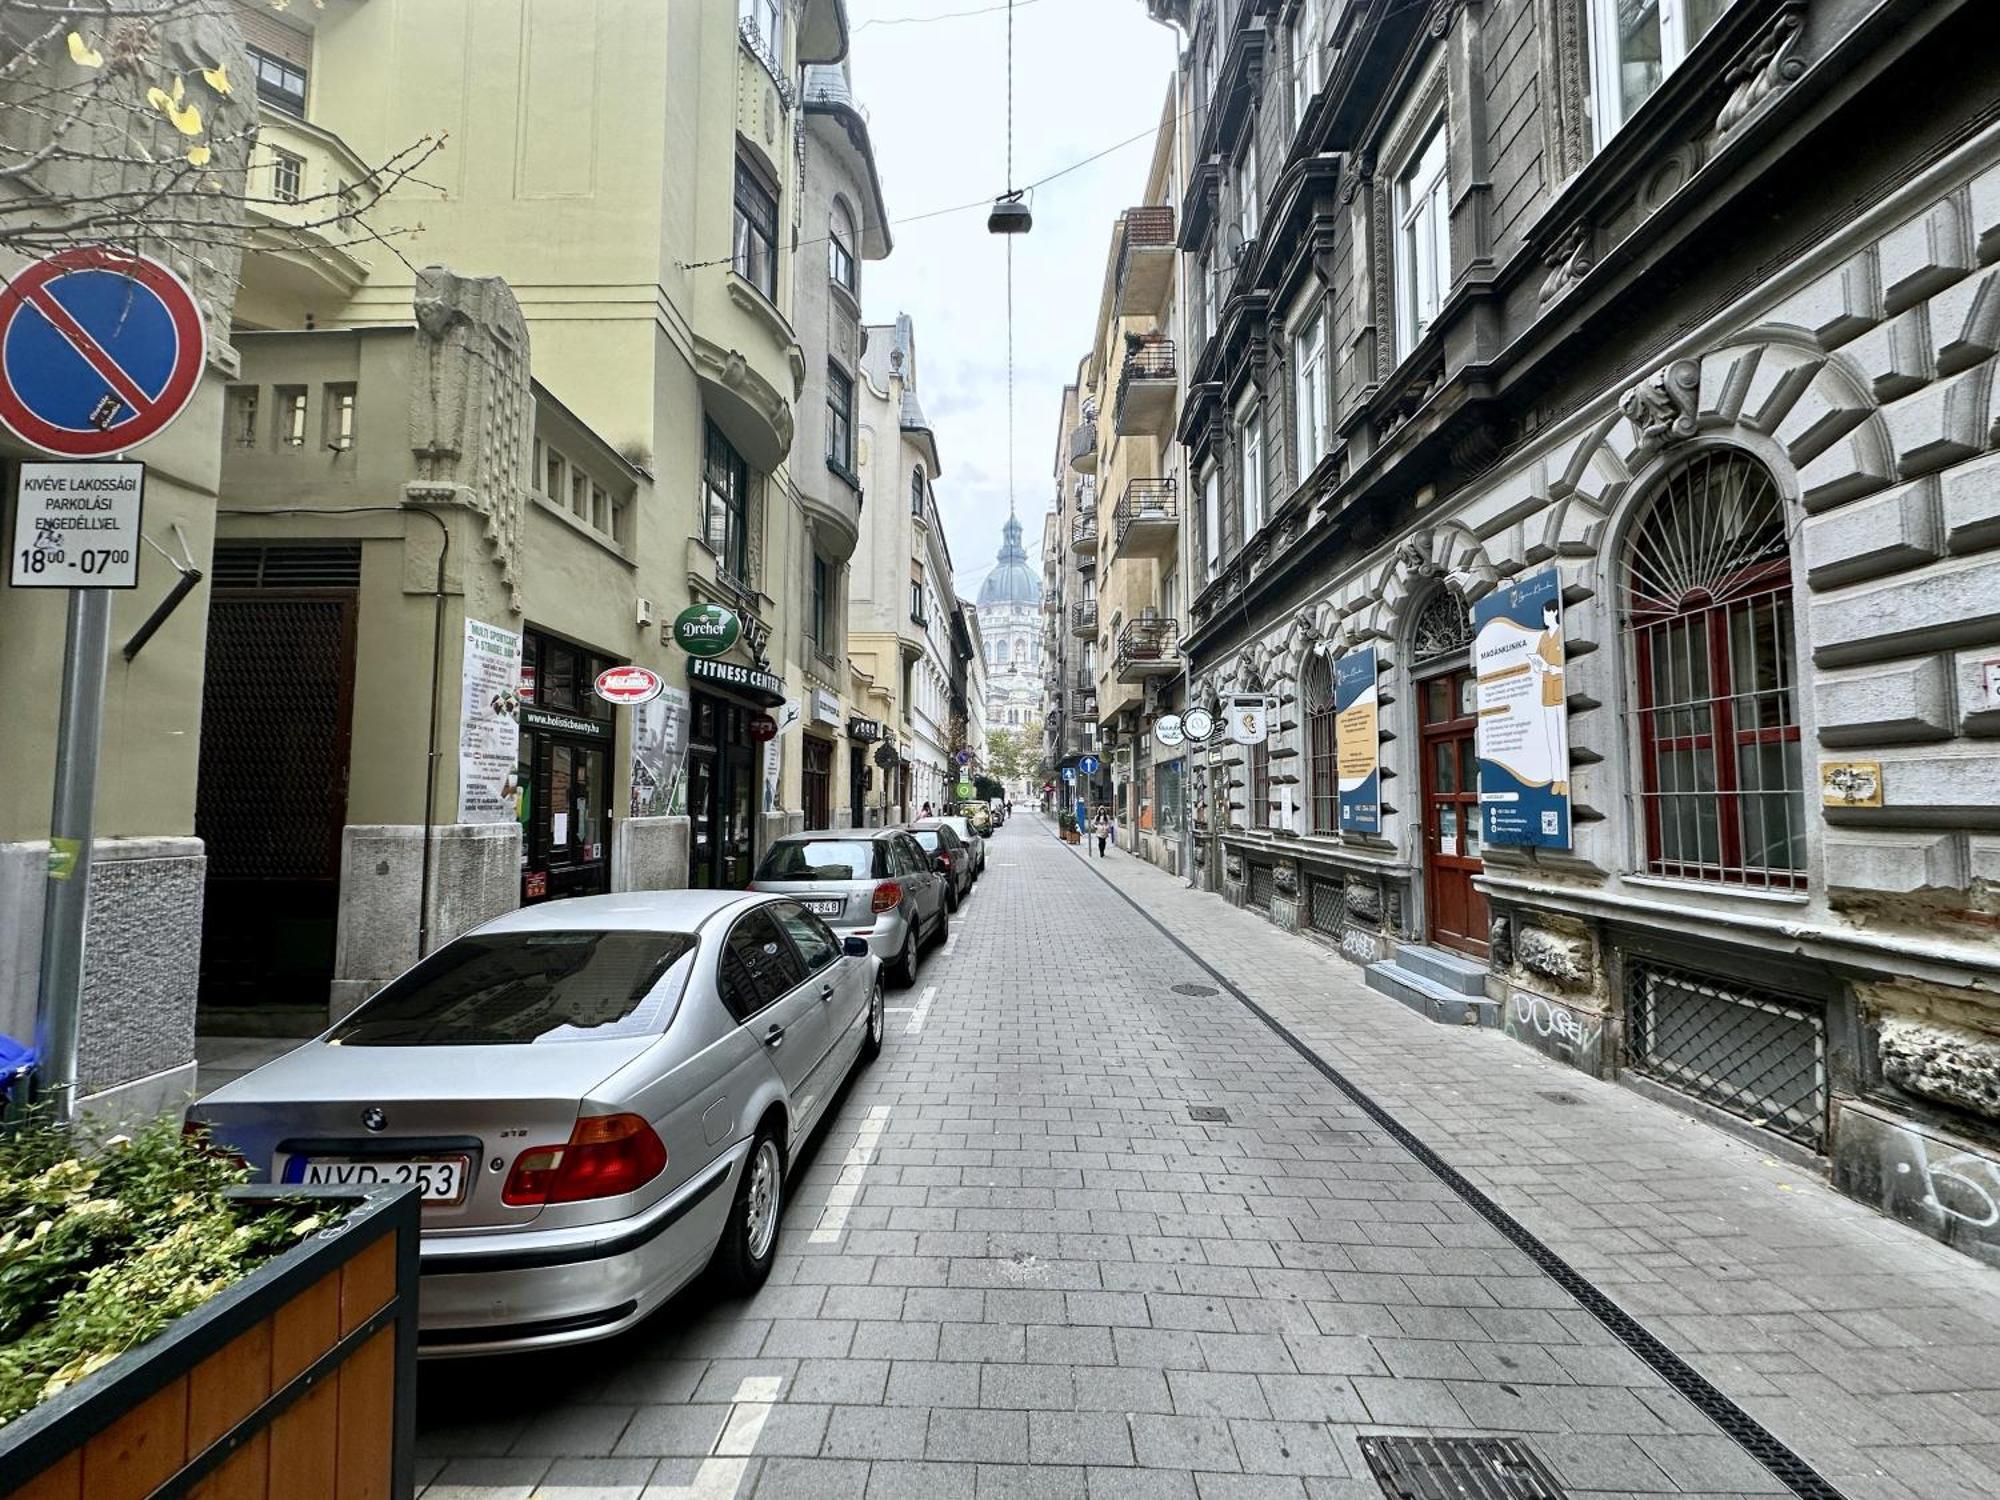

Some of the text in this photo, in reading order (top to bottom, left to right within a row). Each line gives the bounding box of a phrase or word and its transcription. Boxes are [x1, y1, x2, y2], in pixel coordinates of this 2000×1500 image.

[24, 475, 137, 491] KIVÉVE LAKOSSÁGI
[45, 495, 112, 510] PARKOLÁSI
[35, 515, 120, 530] ENGEDÉLLYEL
[682, 622, 726, 637] Dreher
[1480, 639, 1528, 660] MAGÁNKLINIKA
[693, 659, 749, 683] FITNESS
[750, 672, 780, 692] CENTER
[527, 713, 600, 734] www.holisticbeauty.hu
